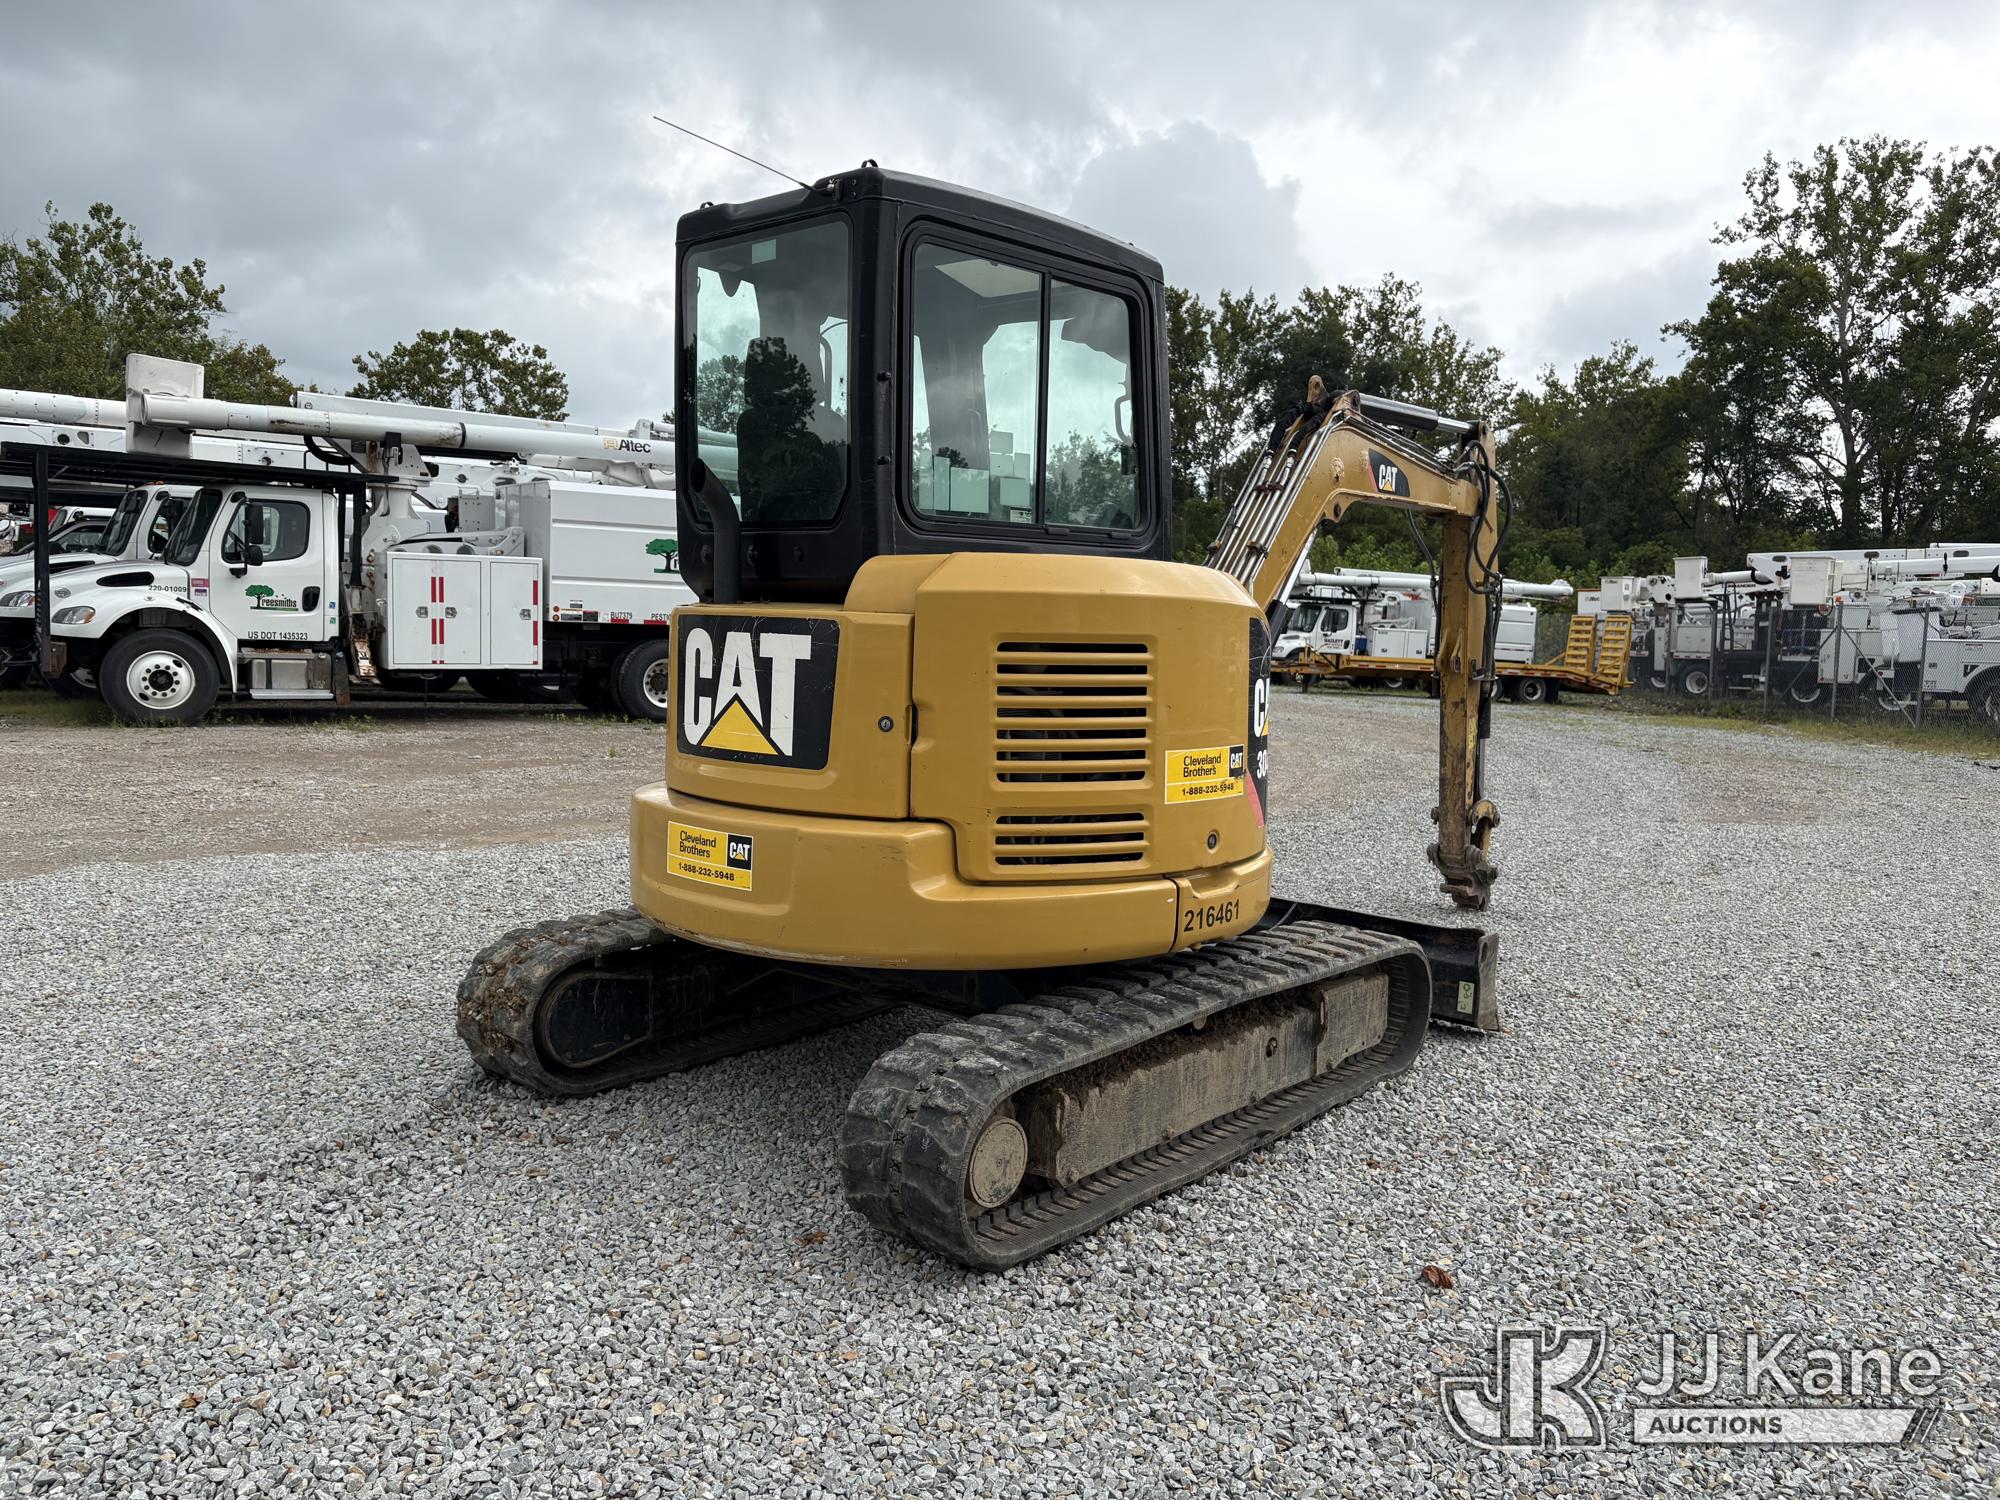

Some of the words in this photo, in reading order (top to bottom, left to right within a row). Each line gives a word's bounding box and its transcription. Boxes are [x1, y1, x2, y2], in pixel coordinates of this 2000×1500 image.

[619, 439, 651, 453] Altec
[1379, 464, 1398, 492] CAT
[247, 631, 259, 639] US
[260, 631, 277, 640] DOT
[279, 632, 308, 640] 1435323
[684, 627, 812, 757] CAT
[1183, 754, 1222, 767] Cleveland
[1230, 752, 1243, 769] CAT
[1183, 765, 1217, 778] Brothers
[1182, 782, 1234, 796] 1-888-232-5948
[680, 830, 717, 848] Cleveland
[679, 841, 711, 858] Brothers
[729, 842, 751, 861] CAT
[678, 862, 735, 881] 1-888-232-5948
[1183, 899, 1240, 932] 216461
